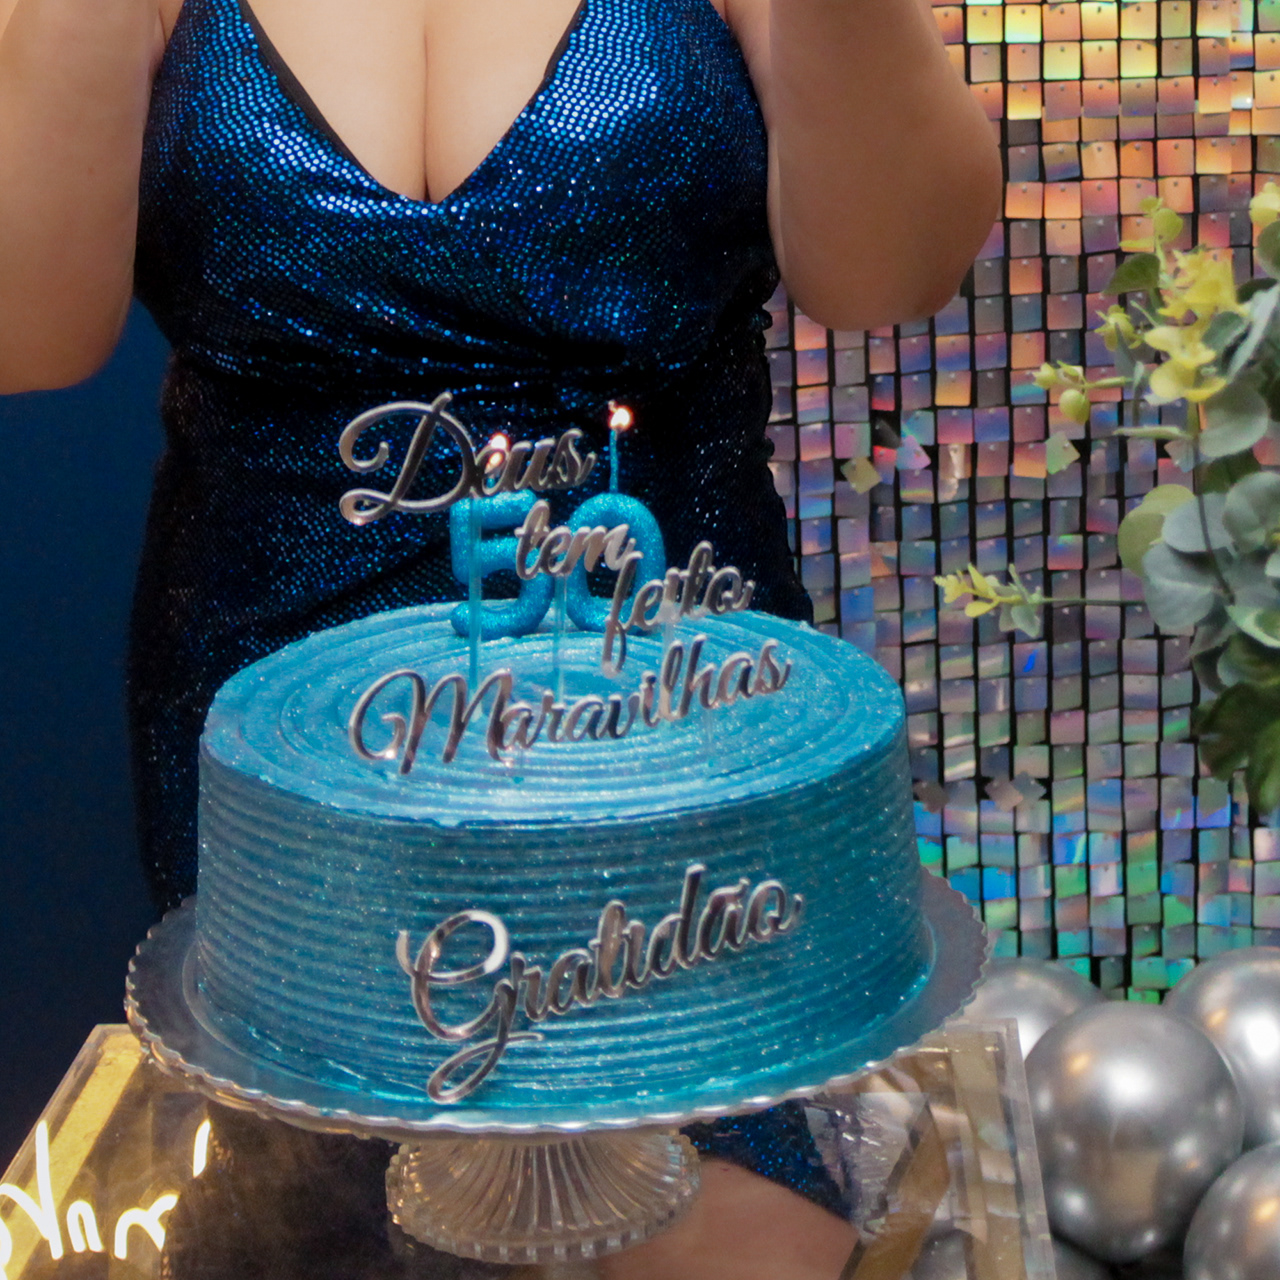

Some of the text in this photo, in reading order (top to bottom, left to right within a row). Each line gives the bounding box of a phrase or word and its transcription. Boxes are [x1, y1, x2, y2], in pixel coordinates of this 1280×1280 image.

[338, 391, 598, 526] Deus
[449, 487, 667, 638] 50
[513, 498, 637, 581] tem
[601, 540, 756, 679] feito
[348, 632, 794, 777] Maravilhas
[395, 863, 806, 1105] Gratidão
